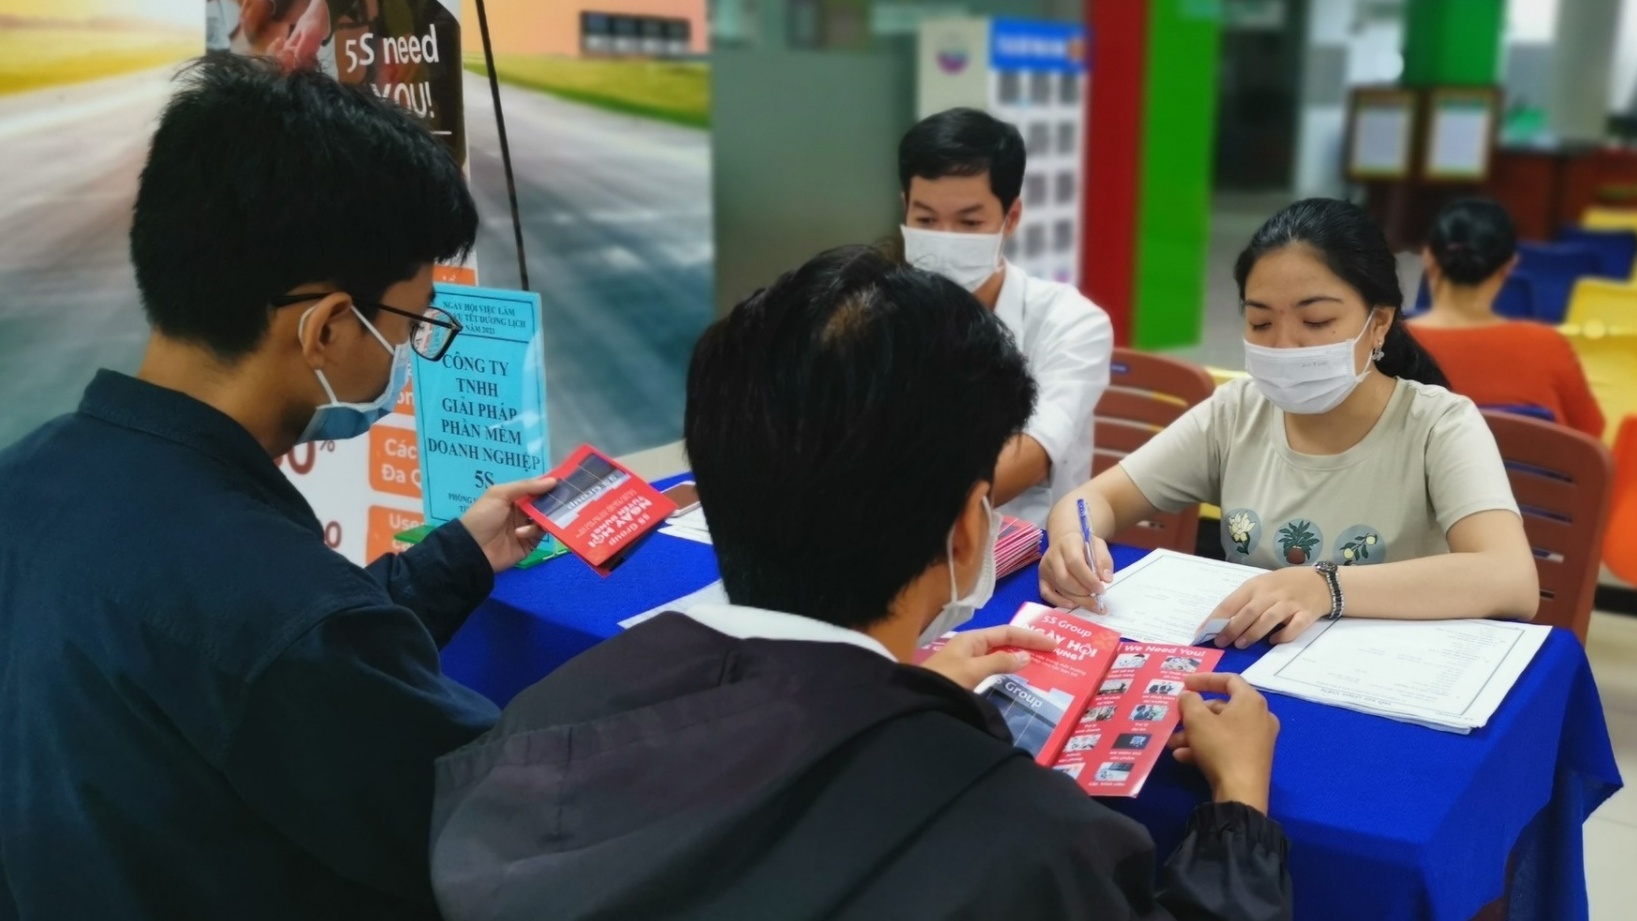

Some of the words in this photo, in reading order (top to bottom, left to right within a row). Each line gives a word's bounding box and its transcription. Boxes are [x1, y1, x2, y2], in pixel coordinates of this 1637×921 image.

[345, 33, 375, 73] 5S
[383, 24, 439, 64] need
[370, 82, 435, 118] YOU!
[508, 320, 526, 329] LỊCH
[442, 351, 485, 373] CÔNG
[488, 360, 509, 376] TY
[456, 377, 498, 397] TNHH
[478, 402, 517, 421] PHÁP
[384, 438, 417, 459] Các
[428, 438, 479, 460] DOANH
[482, 447, 541, 472] NGHIỆP
[382, 463, 406, 484] Đa
[474, 470, 495, 489] 5S
[1058, 620, 1092, 637] Group
[1053, 649, 1080, 661] ỤNG
[1125, 645, 1143, 653] We
[1145, 645, 1177, 654] Need
[1180, 647, 1207, 657] You!
[1005, 682, 1043, 708] Group
